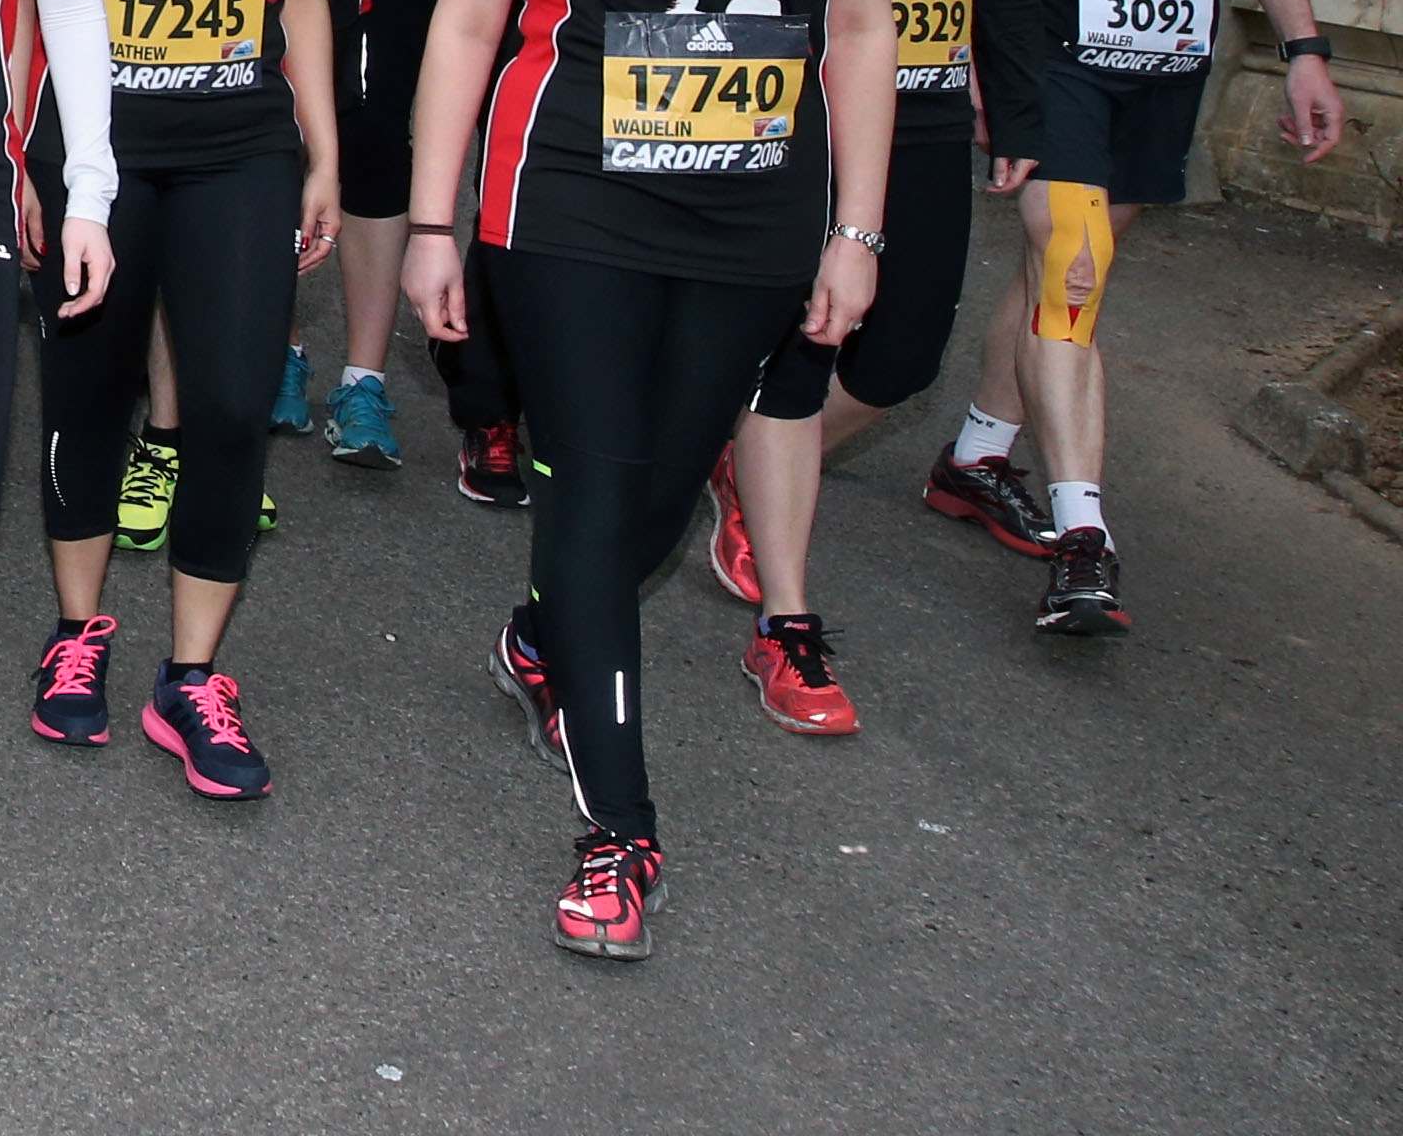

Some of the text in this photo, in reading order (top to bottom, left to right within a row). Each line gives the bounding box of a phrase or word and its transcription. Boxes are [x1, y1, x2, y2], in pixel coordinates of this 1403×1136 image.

[686, 40, 734, 52] adidas
[1087, 31, 1134, 47] WALLER
[1077, 48, 1203, 73] CARDIFF 2016
[210, 61, 255, 88] 2016
[940, 66, 968, 89] 2016
[628, 64, 785, 113] 17740
[612, 118, 693, 137] WADELIN
[611, 141, 786, 170] CARDIFF 2016
